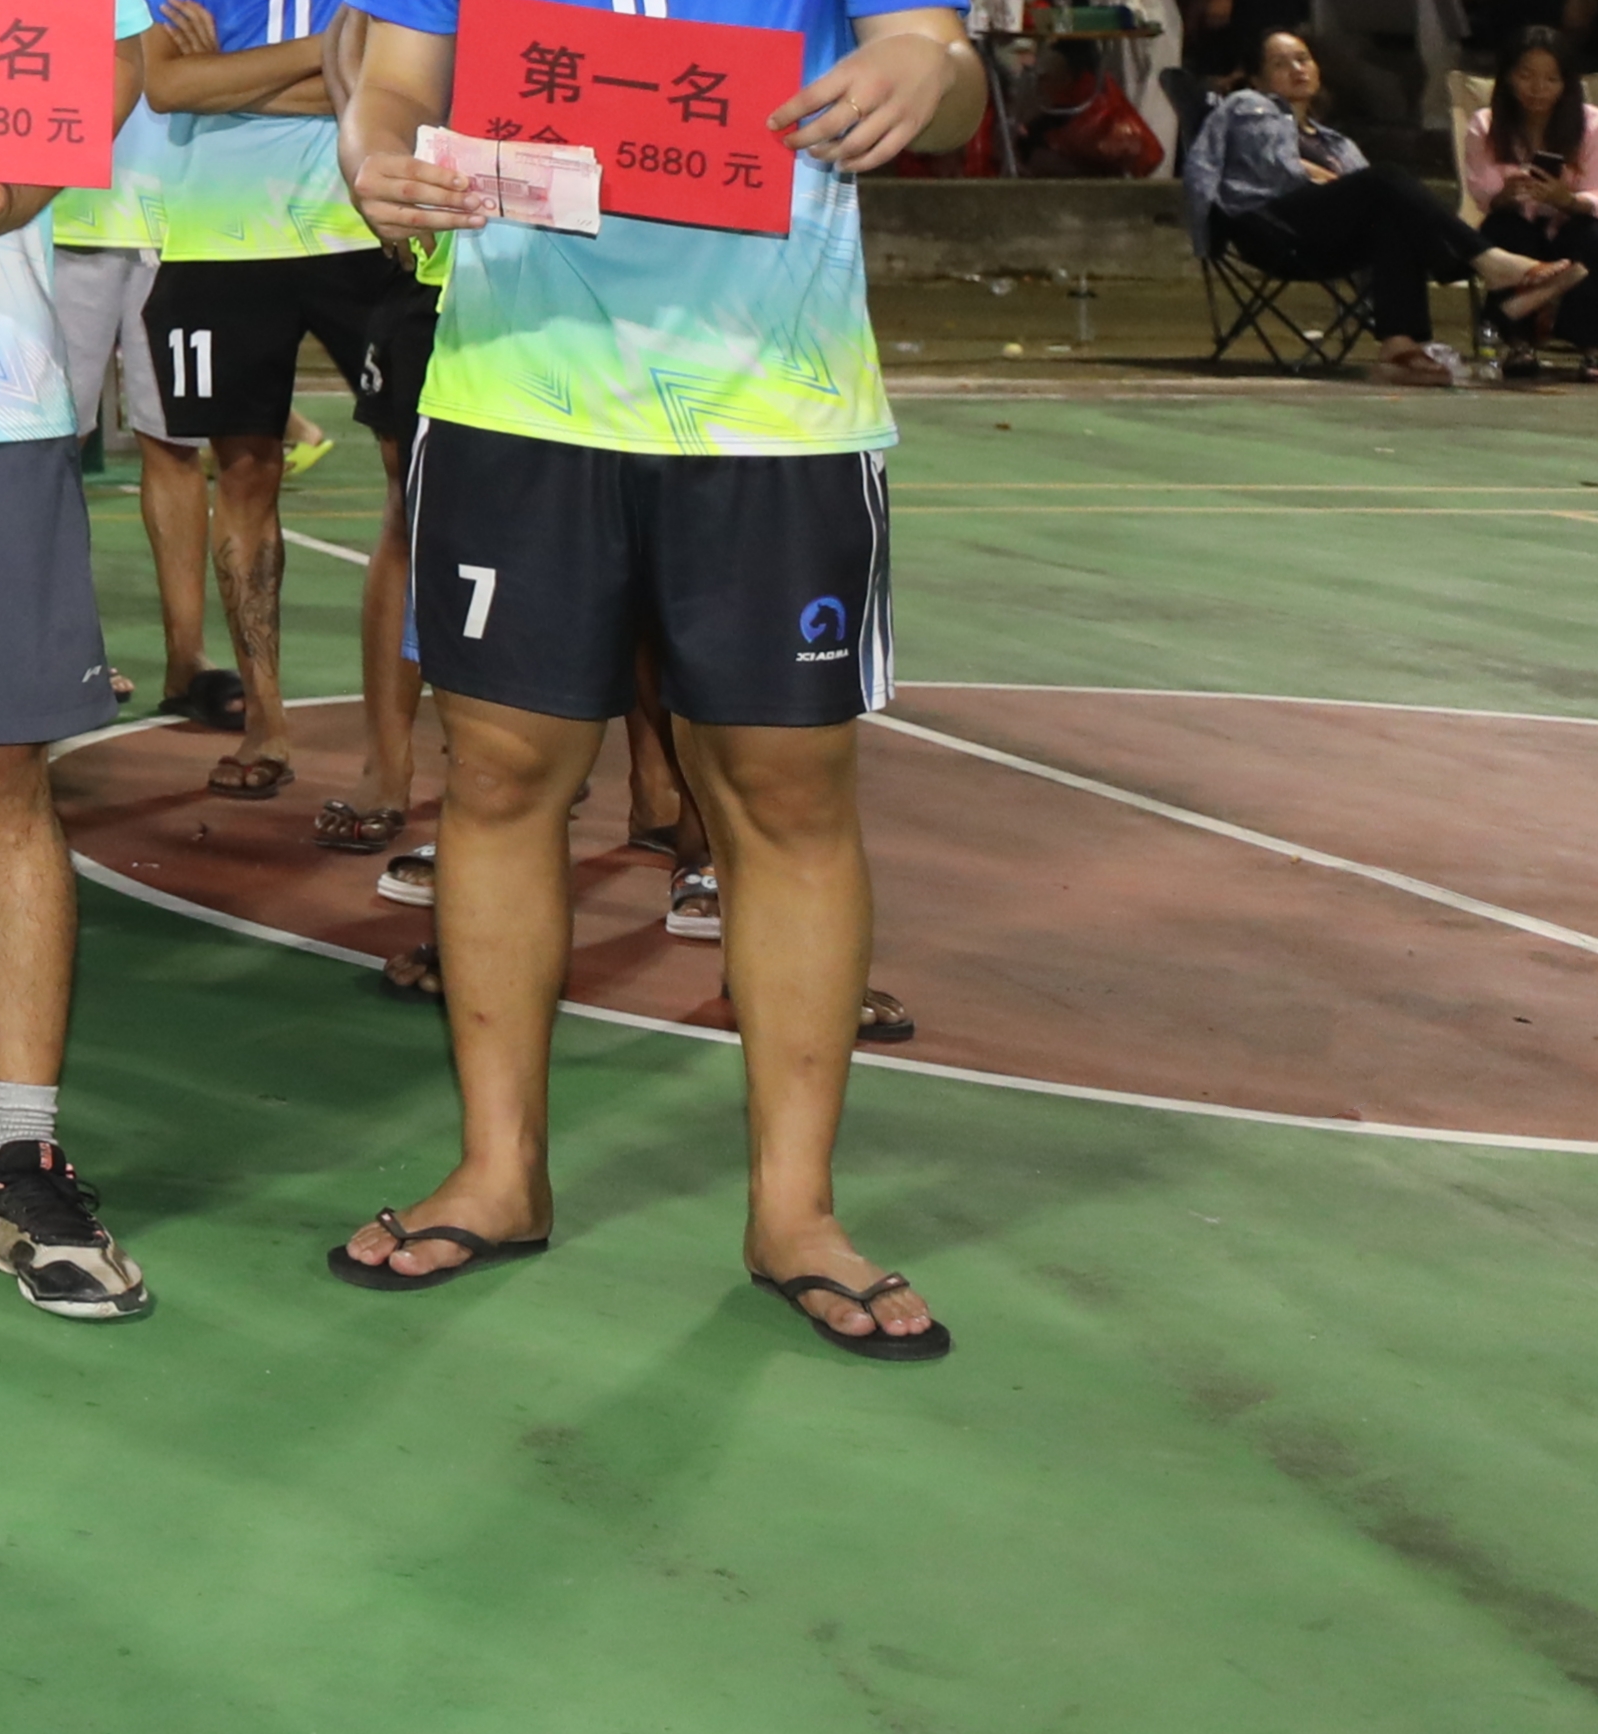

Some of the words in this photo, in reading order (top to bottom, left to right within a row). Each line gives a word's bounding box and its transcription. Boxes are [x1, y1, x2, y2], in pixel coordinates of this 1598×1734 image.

[518, 40, 729, 127] 第一名
[48, 107, 85, 144] 元
[722, 151, 764, 189] 元
[168, 327, 213, 399] 11
[457, 563, 497, 640] 7
